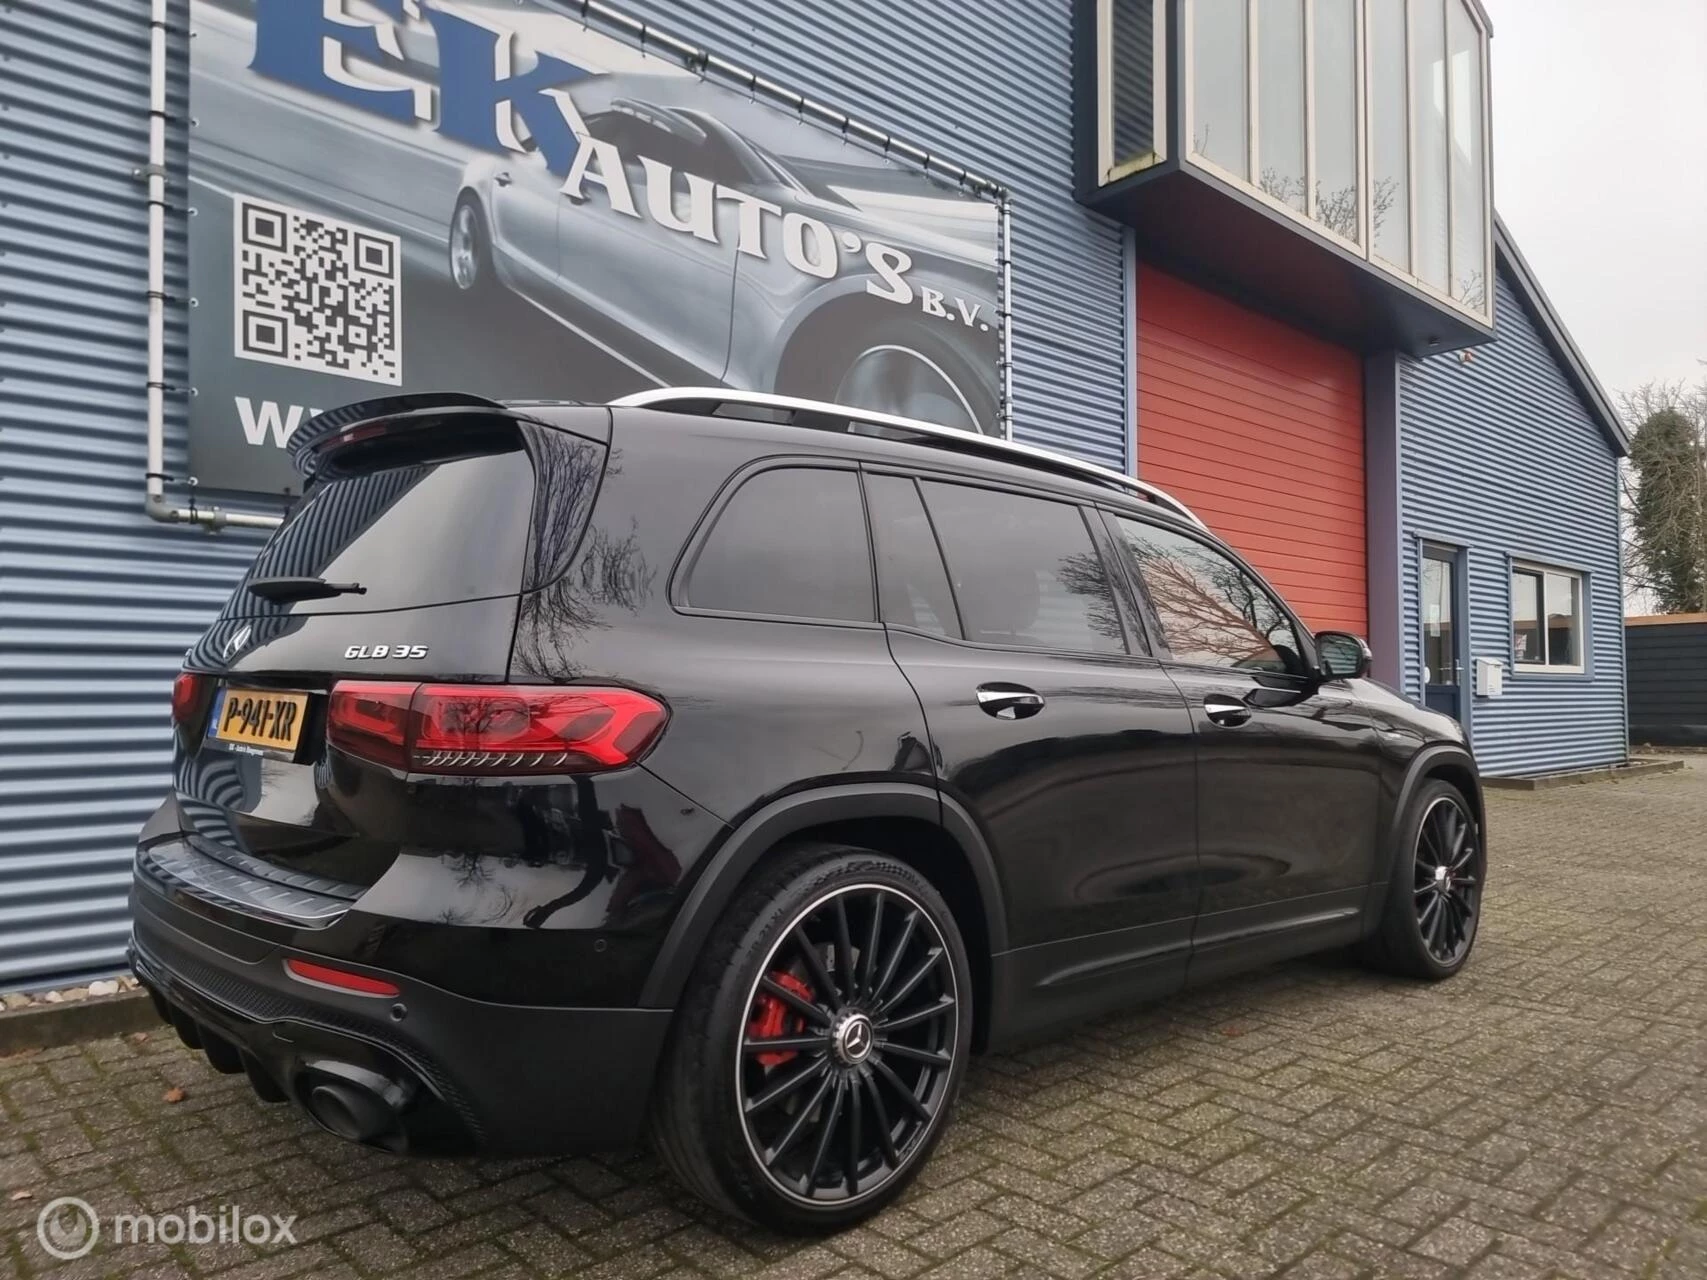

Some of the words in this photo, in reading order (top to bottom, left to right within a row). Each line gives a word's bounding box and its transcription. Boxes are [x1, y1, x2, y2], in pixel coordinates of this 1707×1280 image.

[248, 0, 610, 180] EK
[920, 286, 990, 332] B.V.
[344, 645, 389, 660] GLB
[392, 645, 429, 659] 35
[223, 696, 298, 742] P-941-XR
